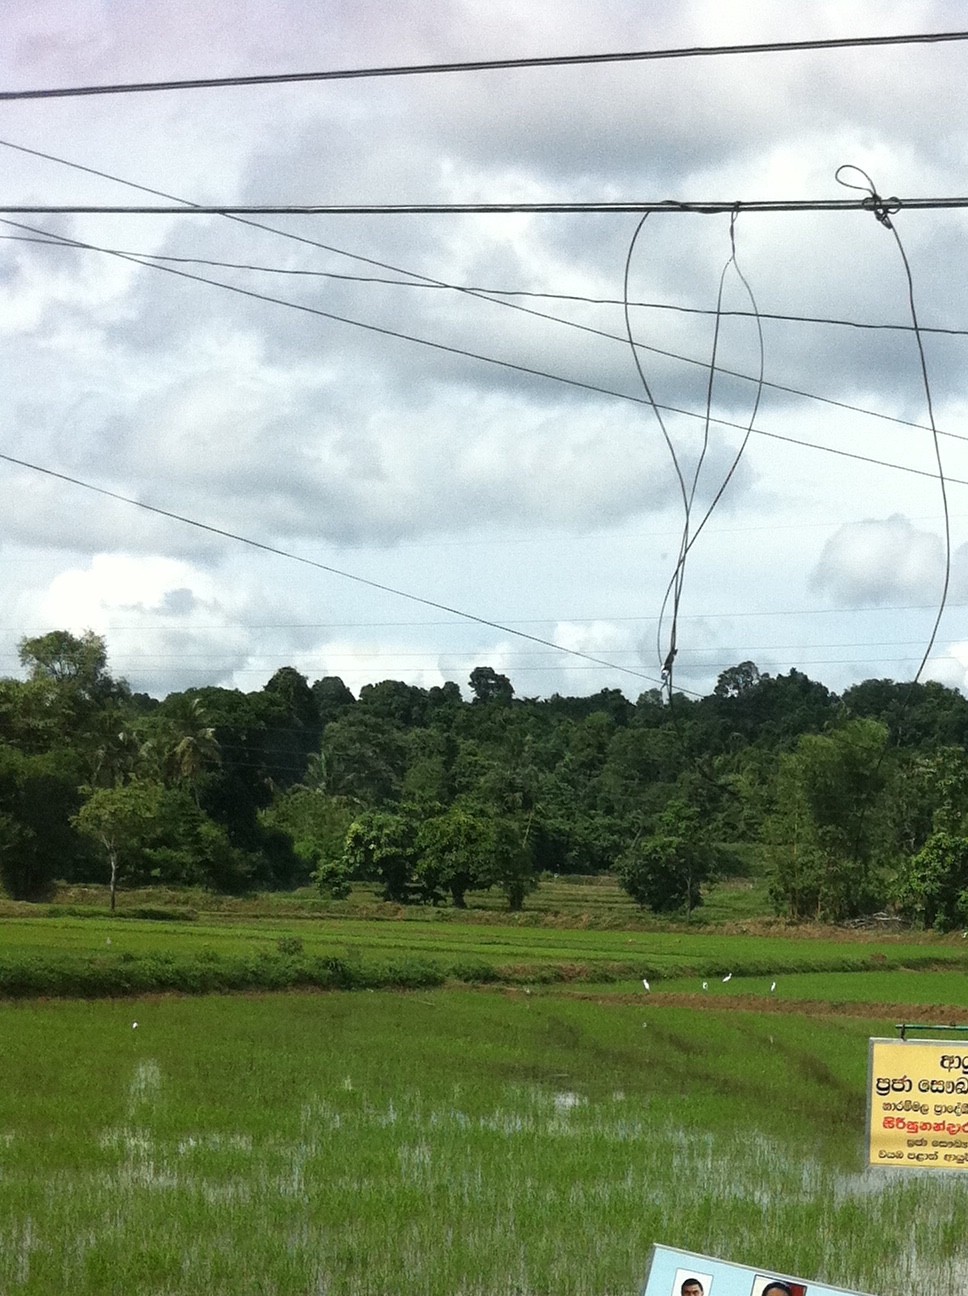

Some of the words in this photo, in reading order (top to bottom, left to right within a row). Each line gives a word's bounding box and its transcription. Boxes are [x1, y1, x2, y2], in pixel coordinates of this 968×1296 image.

[876, 1076, 913, 1096] ප්‍රජා
[882, 1101, 930, 1115] නාරම්මල
[906, 1138, 929, 1148] ප්‍රජා
[931, 1140, 968, 1149] සෞඛ්‍ය
[878, 1151, 905, 1159] වයඹ
[907, 1152, 940, 1162] පළාත්
